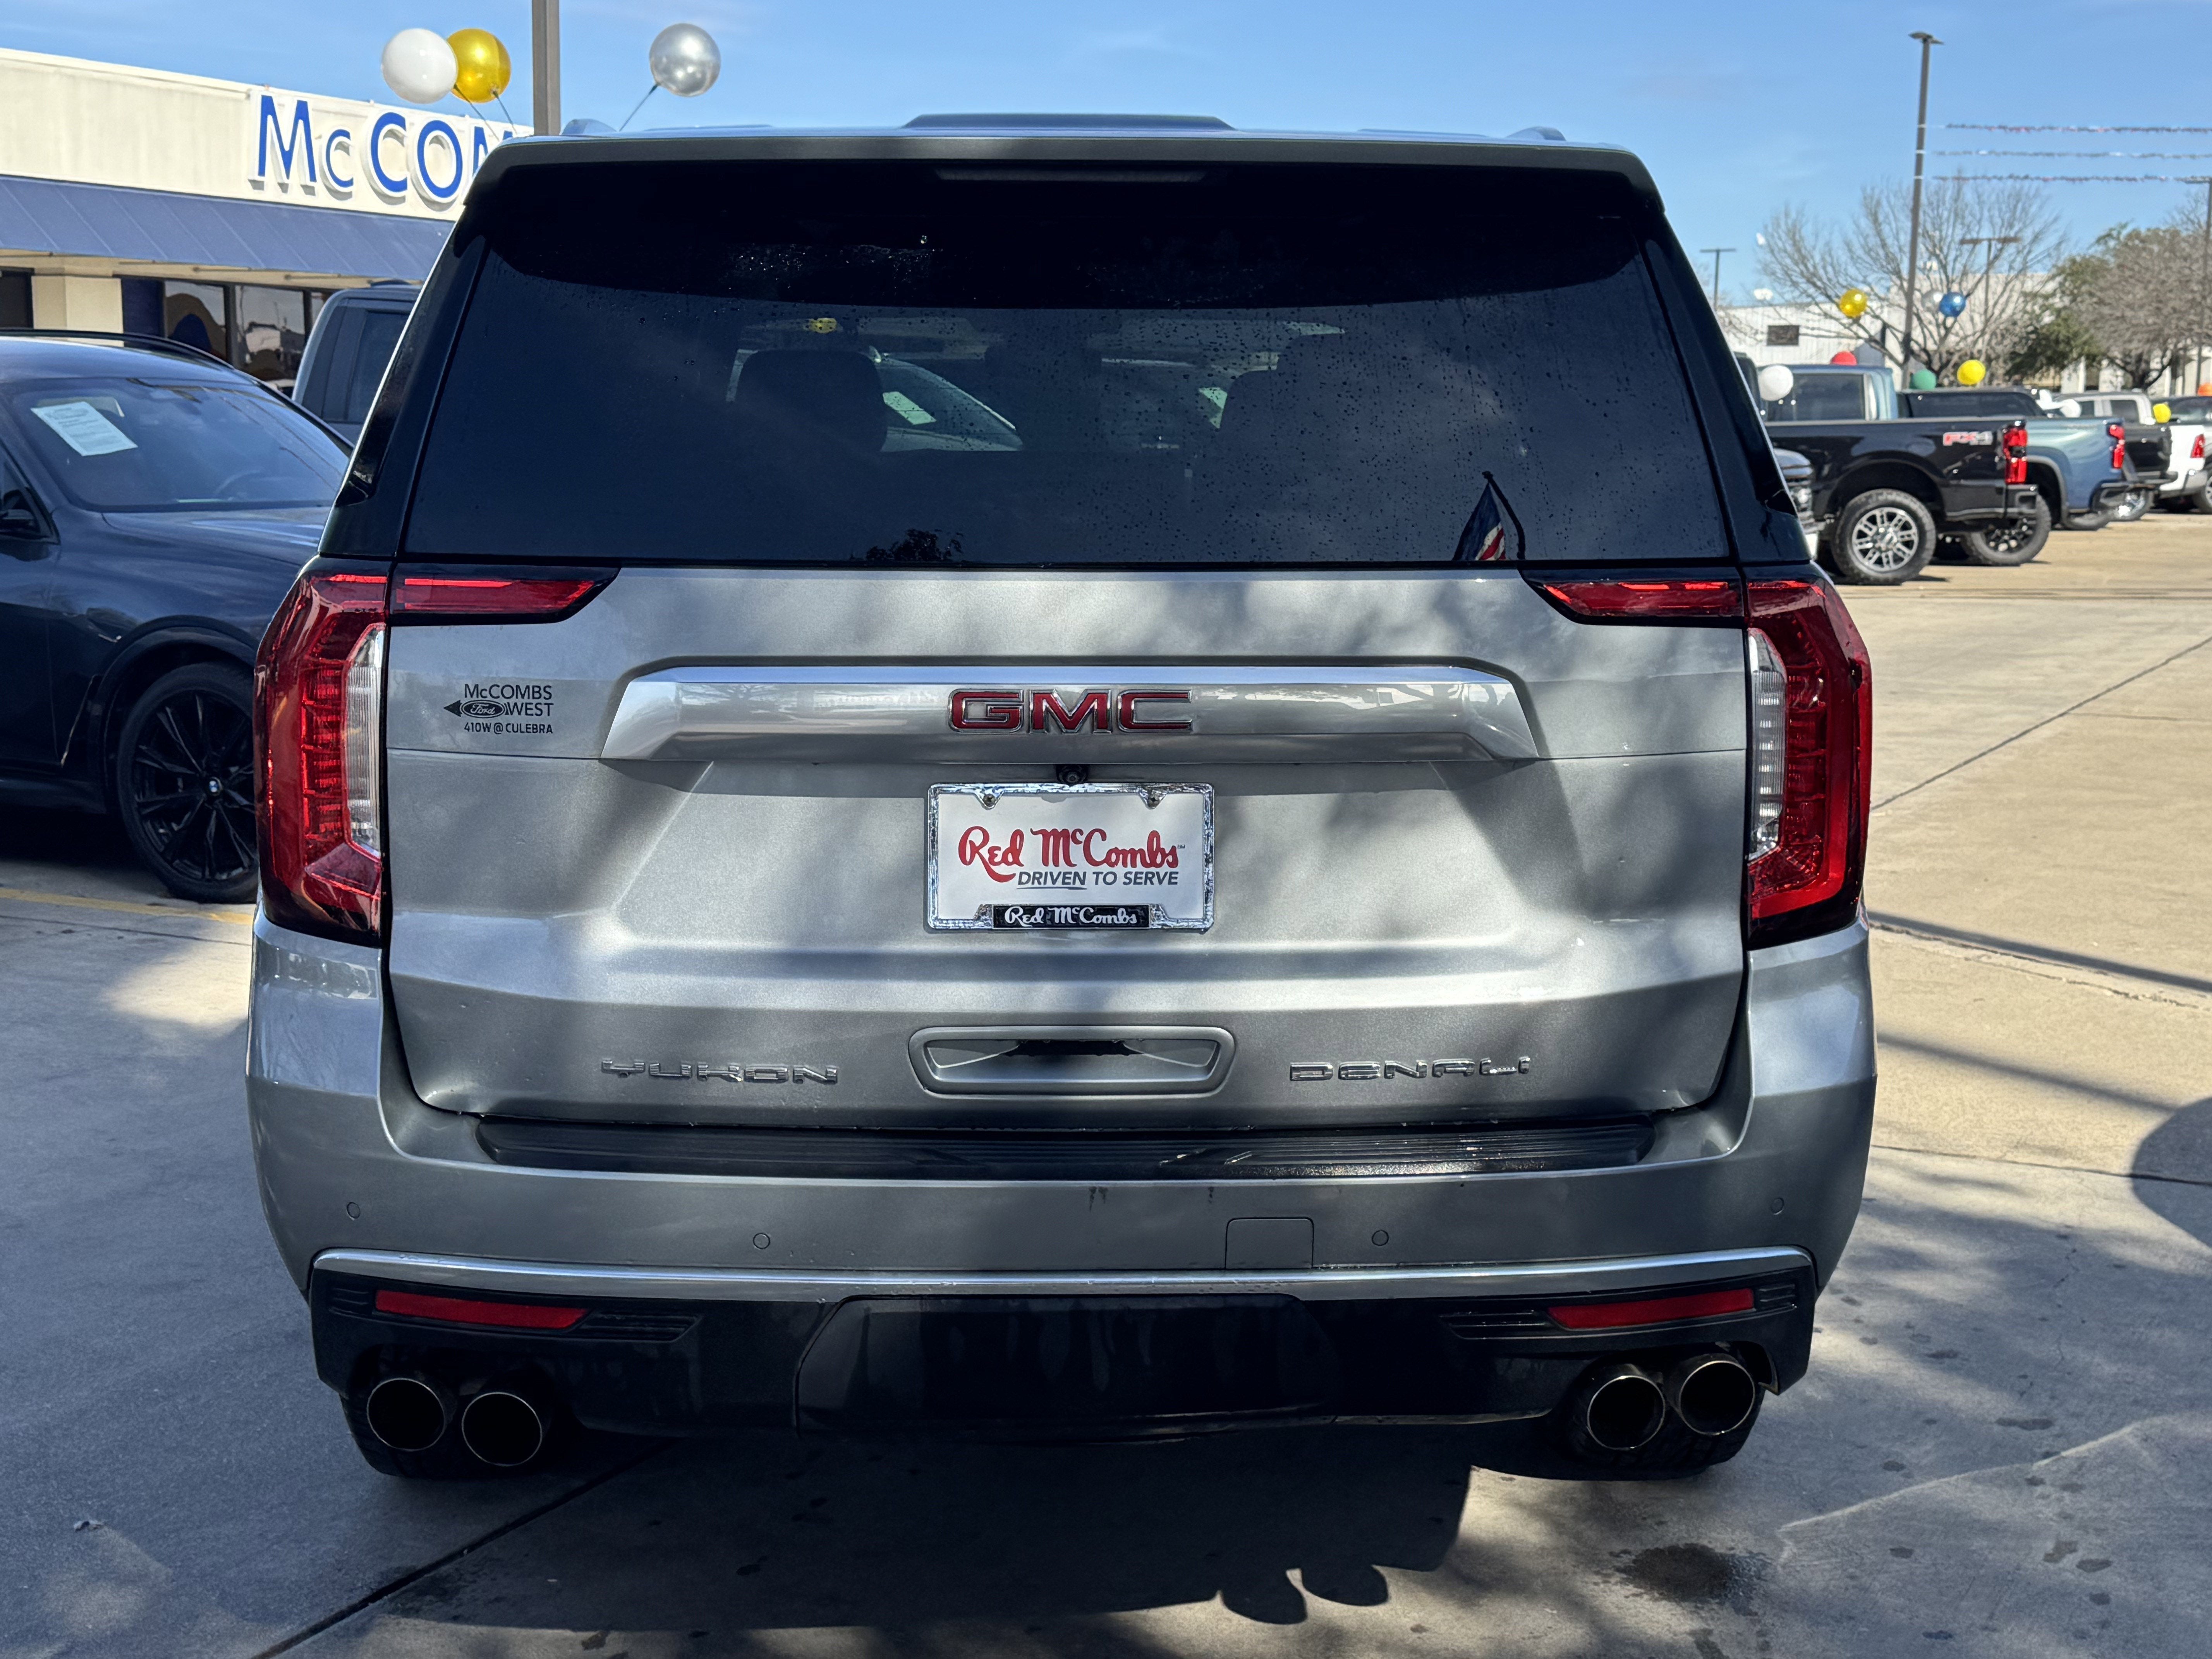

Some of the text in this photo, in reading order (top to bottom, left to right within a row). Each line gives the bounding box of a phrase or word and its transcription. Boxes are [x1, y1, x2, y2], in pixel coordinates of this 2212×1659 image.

[465, 684, 552, 700] McCOMBS
[470, 702, 554, 716] Ford WEST
[948, 689, 1193, 734] GMC
[464, 722, 491, 732] 410W
[506, 723, 553, 734] CULEBRA
[958, 826, 1024, 882] Red
[1030, 828, 1179, 868] McCombs
[1018, 871, 1179, 885] DRIVEN TO SERVE
[1005, 906, 1137, 927] Red McCombs
[601, 1059, 838, 1084] YUKON
[1290, 1056, 1530, 1081] DENALI
